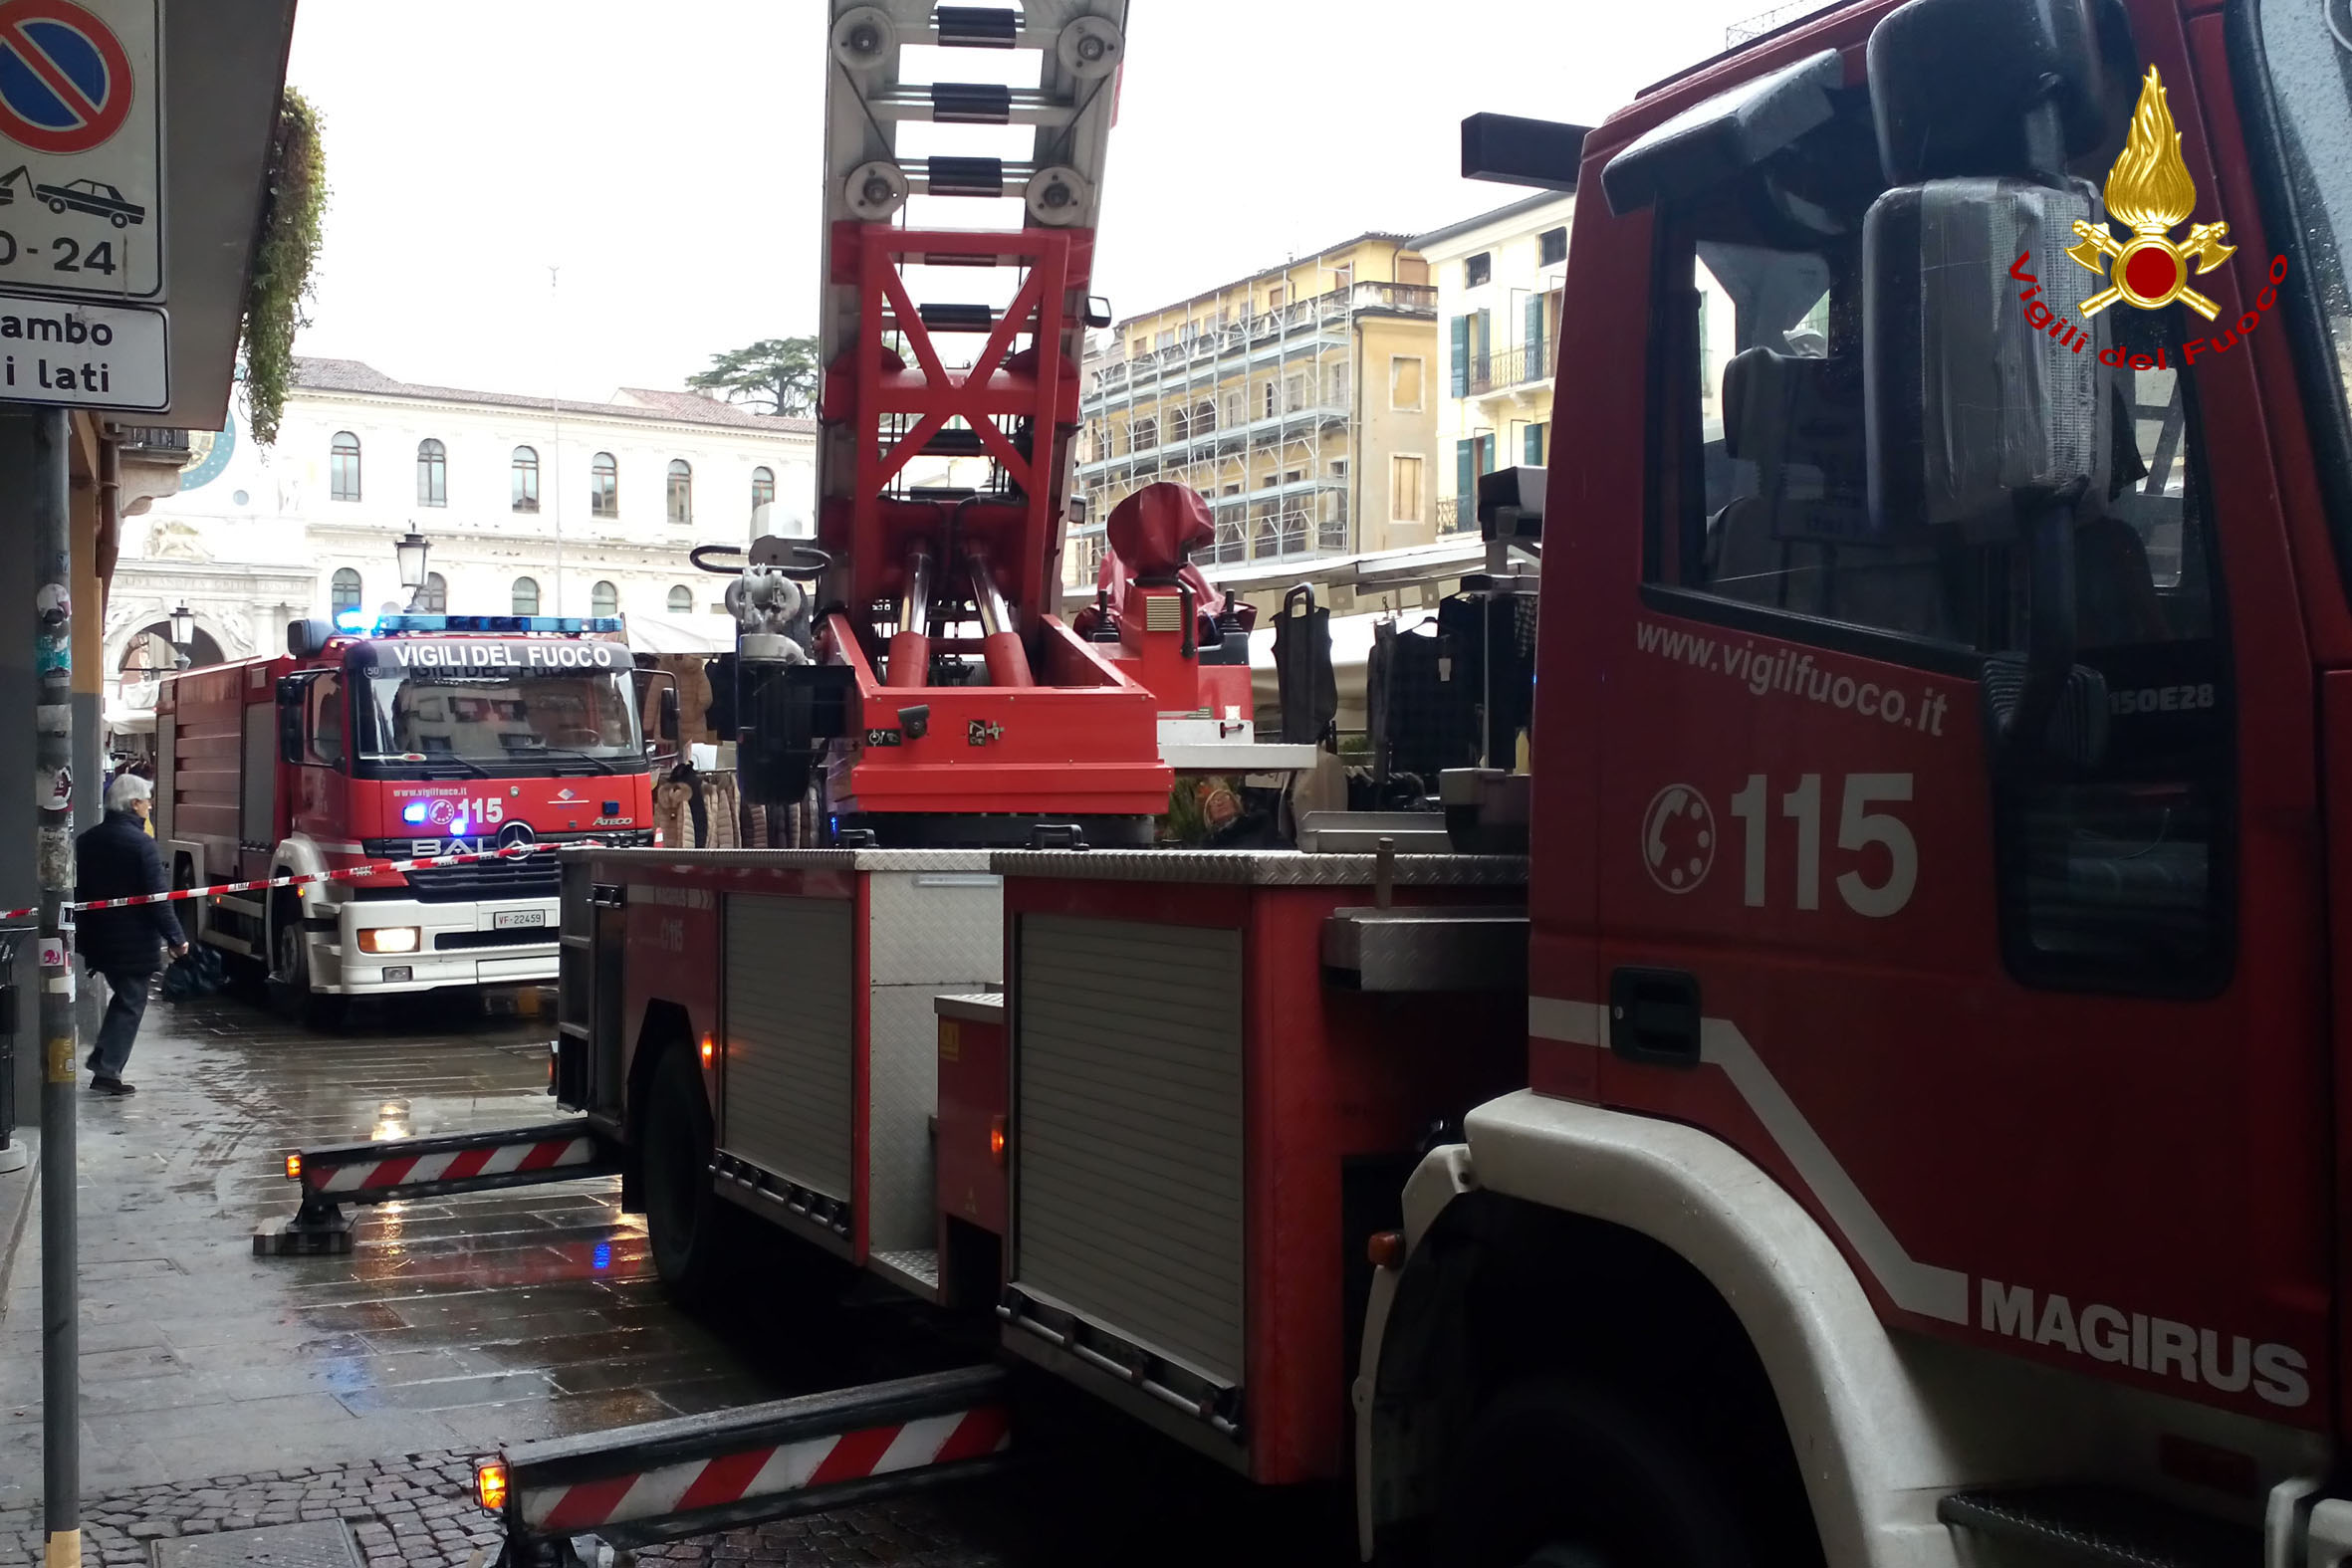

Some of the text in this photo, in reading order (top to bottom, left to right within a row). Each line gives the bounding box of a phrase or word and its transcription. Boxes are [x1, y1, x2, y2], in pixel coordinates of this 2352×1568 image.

[52, 237, 117, 276] 24
[1, 313, 113, 345] ambo
[6, 355, 110, 392] i lati
[393, 645, 611, 667] VIGILI DEL FUOCO
[1636, 620, 1948, 737] www.vigilfuoco.it
[458, 797, 503, 823] 115
[1731, 773, 1919, 918] 115
[1981, 1277, 2310, 1407] MAGIRUS
